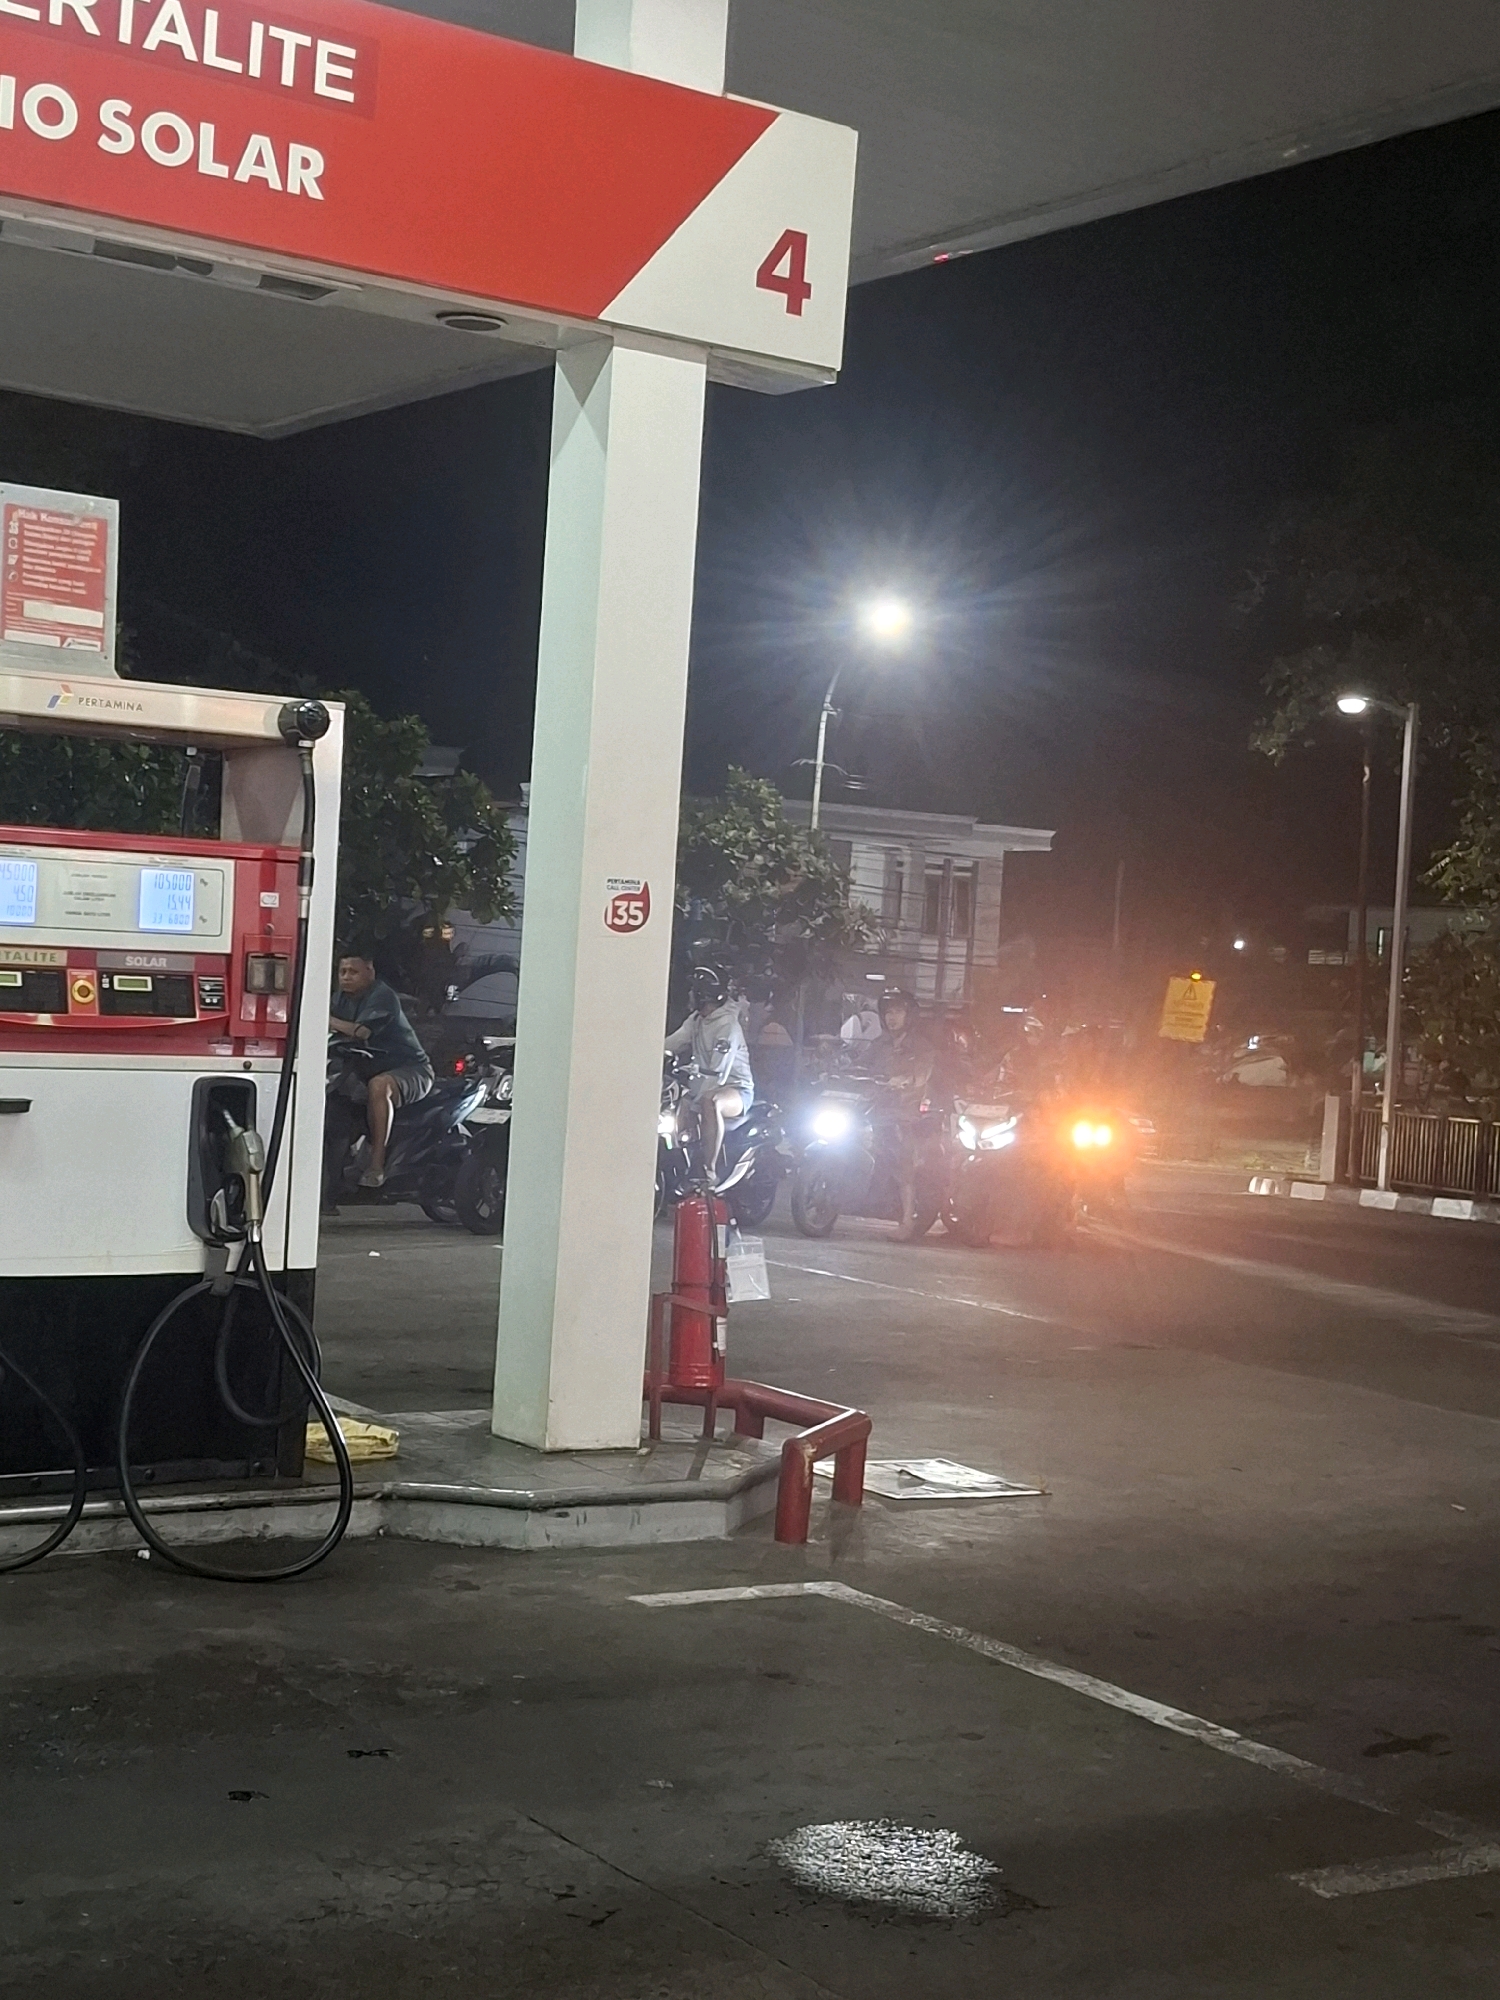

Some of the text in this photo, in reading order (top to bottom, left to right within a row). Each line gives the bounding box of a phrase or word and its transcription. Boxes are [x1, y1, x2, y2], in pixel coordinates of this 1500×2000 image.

[97, 99, 324, 200] SOLAR
[756, 229, 811, 317] 4
[78, 697, 143, 711] PERTAMINA
[154, 873, 192, 891] 105000
[606, 898, 644, 926] 135
[0, 951, 57, 963] TALITE
[125, 956, 167, 968] SOLAR
